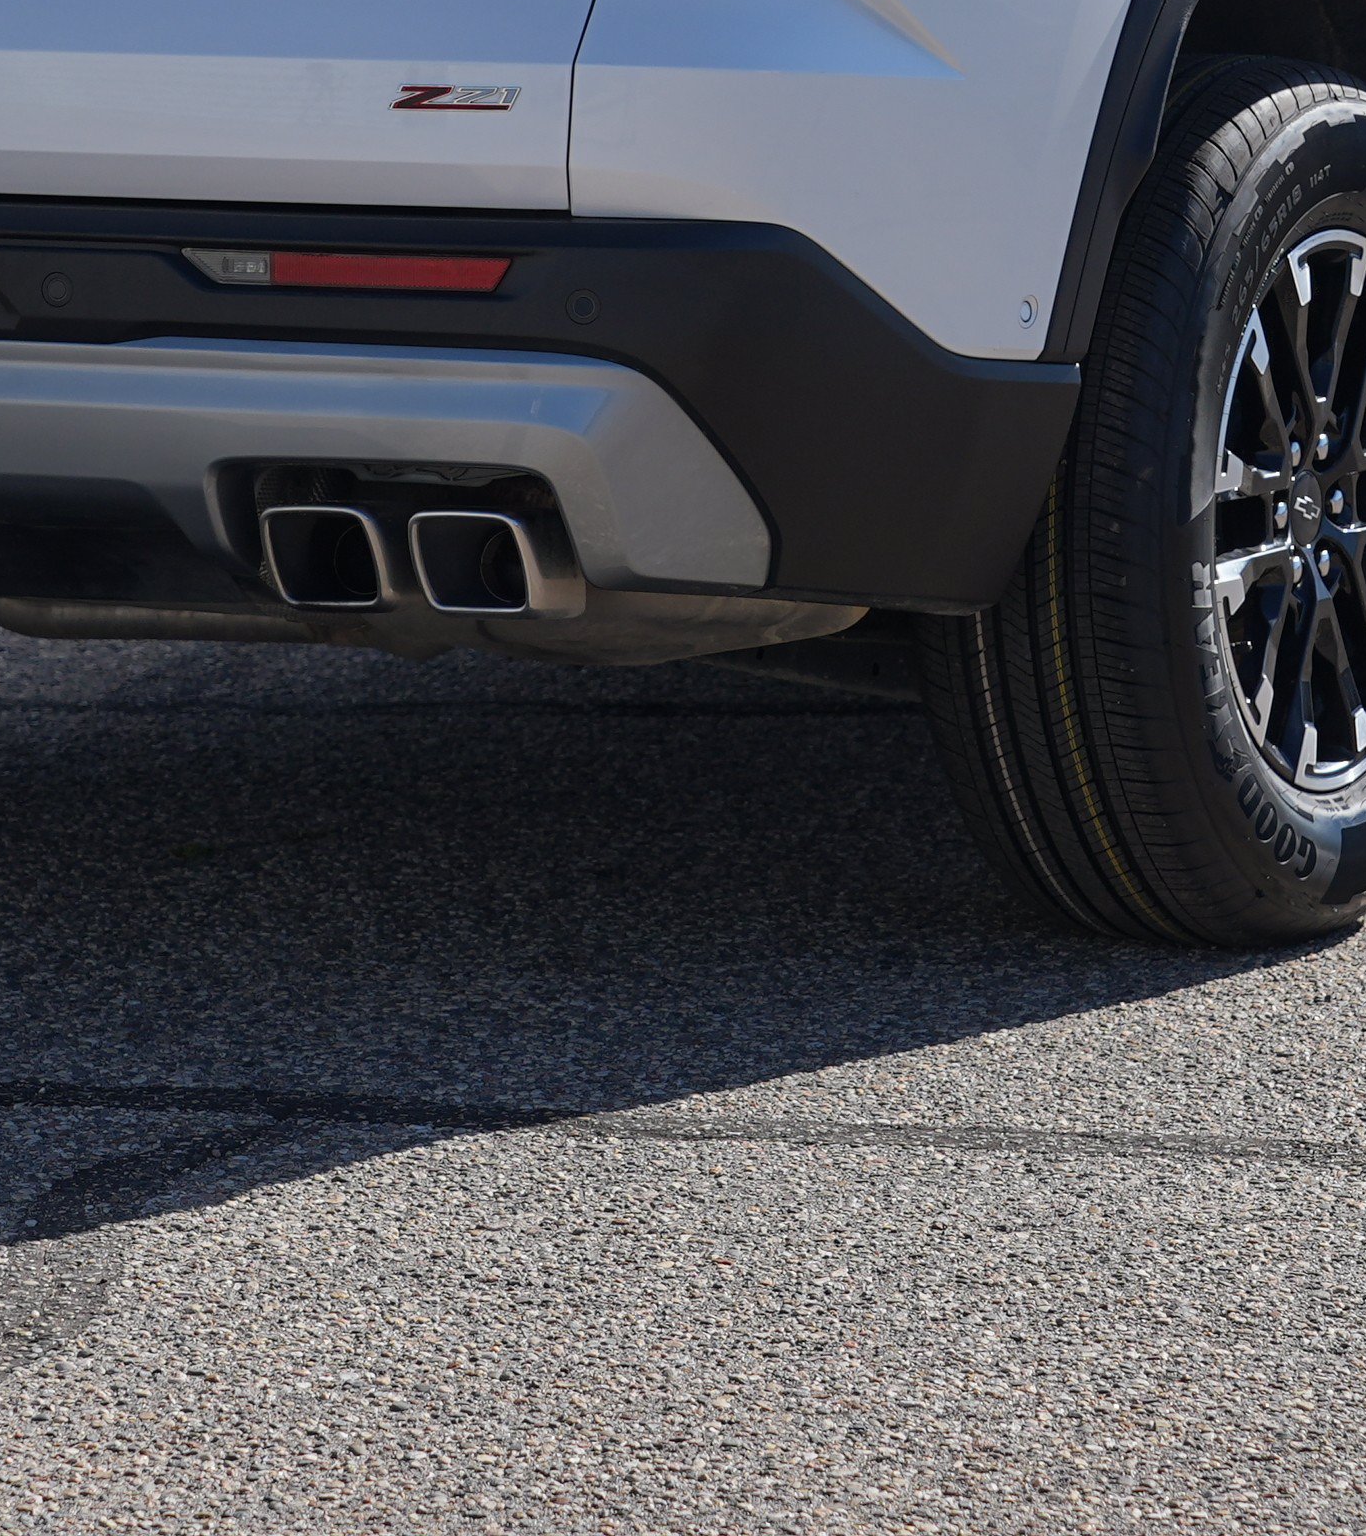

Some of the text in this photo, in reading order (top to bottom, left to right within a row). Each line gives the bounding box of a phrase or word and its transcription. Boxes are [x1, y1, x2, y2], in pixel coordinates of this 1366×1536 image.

[388, 84, 521, 111] Z71
[1231, 183, 1303, 327] 265/65R18
[1191, 561, 1318, 882] GOODYEAR
